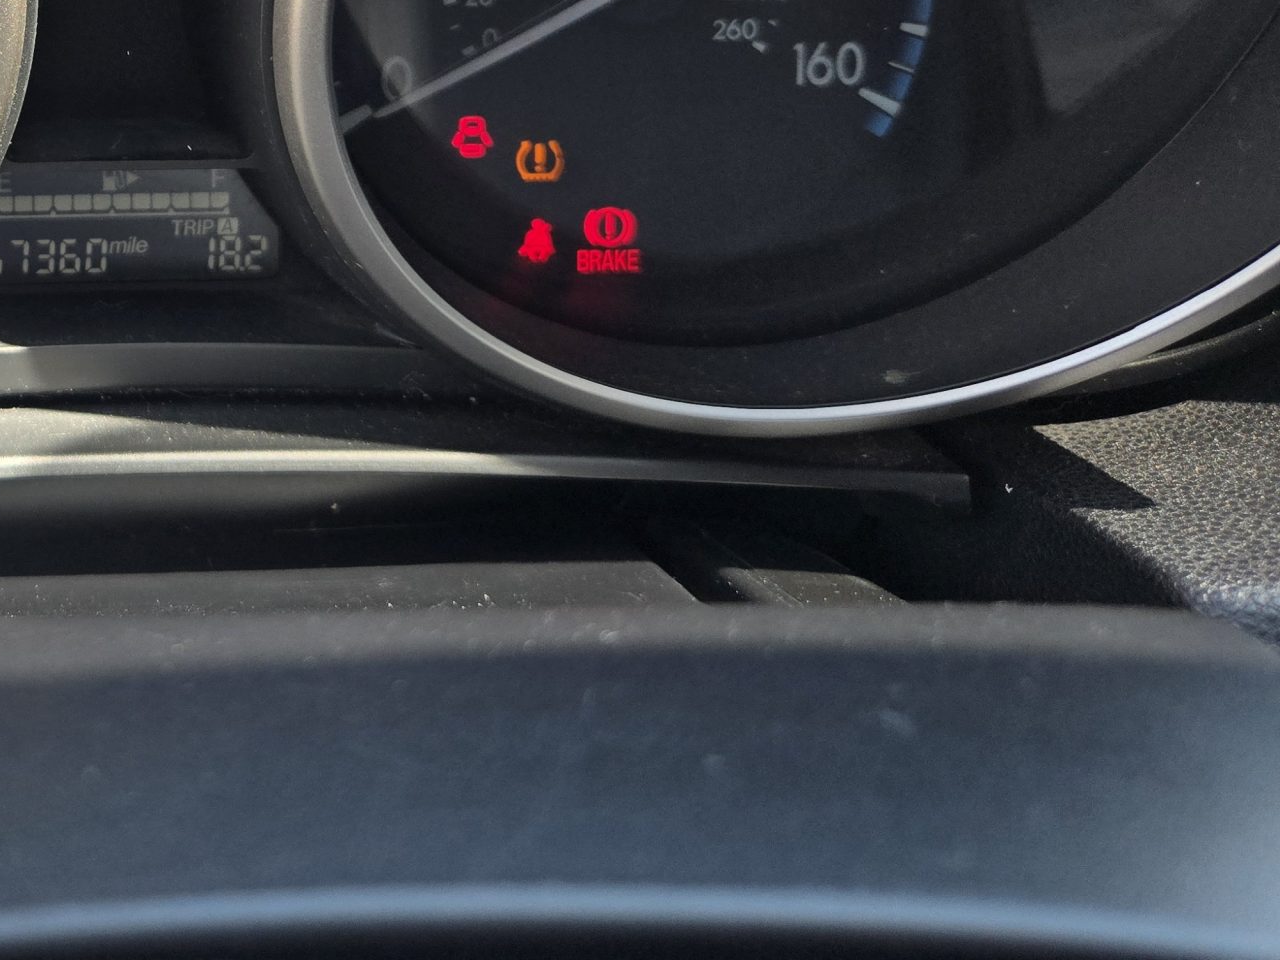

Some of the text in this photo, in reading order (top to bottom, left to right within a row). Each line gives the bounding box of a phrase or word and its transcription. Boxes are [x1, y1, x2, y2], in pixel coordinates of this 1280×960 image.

[482, 28, 497, 46] 0
[713, 19, 758, 40] 260
[794, 42, 865, 86] 160
[381, 56, 412, 101] 0
[211, 169, 227, 189] F
[172, 218, 238, 235] TRIP A
[110, 236, 148, 254] mile
[577, 249, 640, 273] BRAKE
